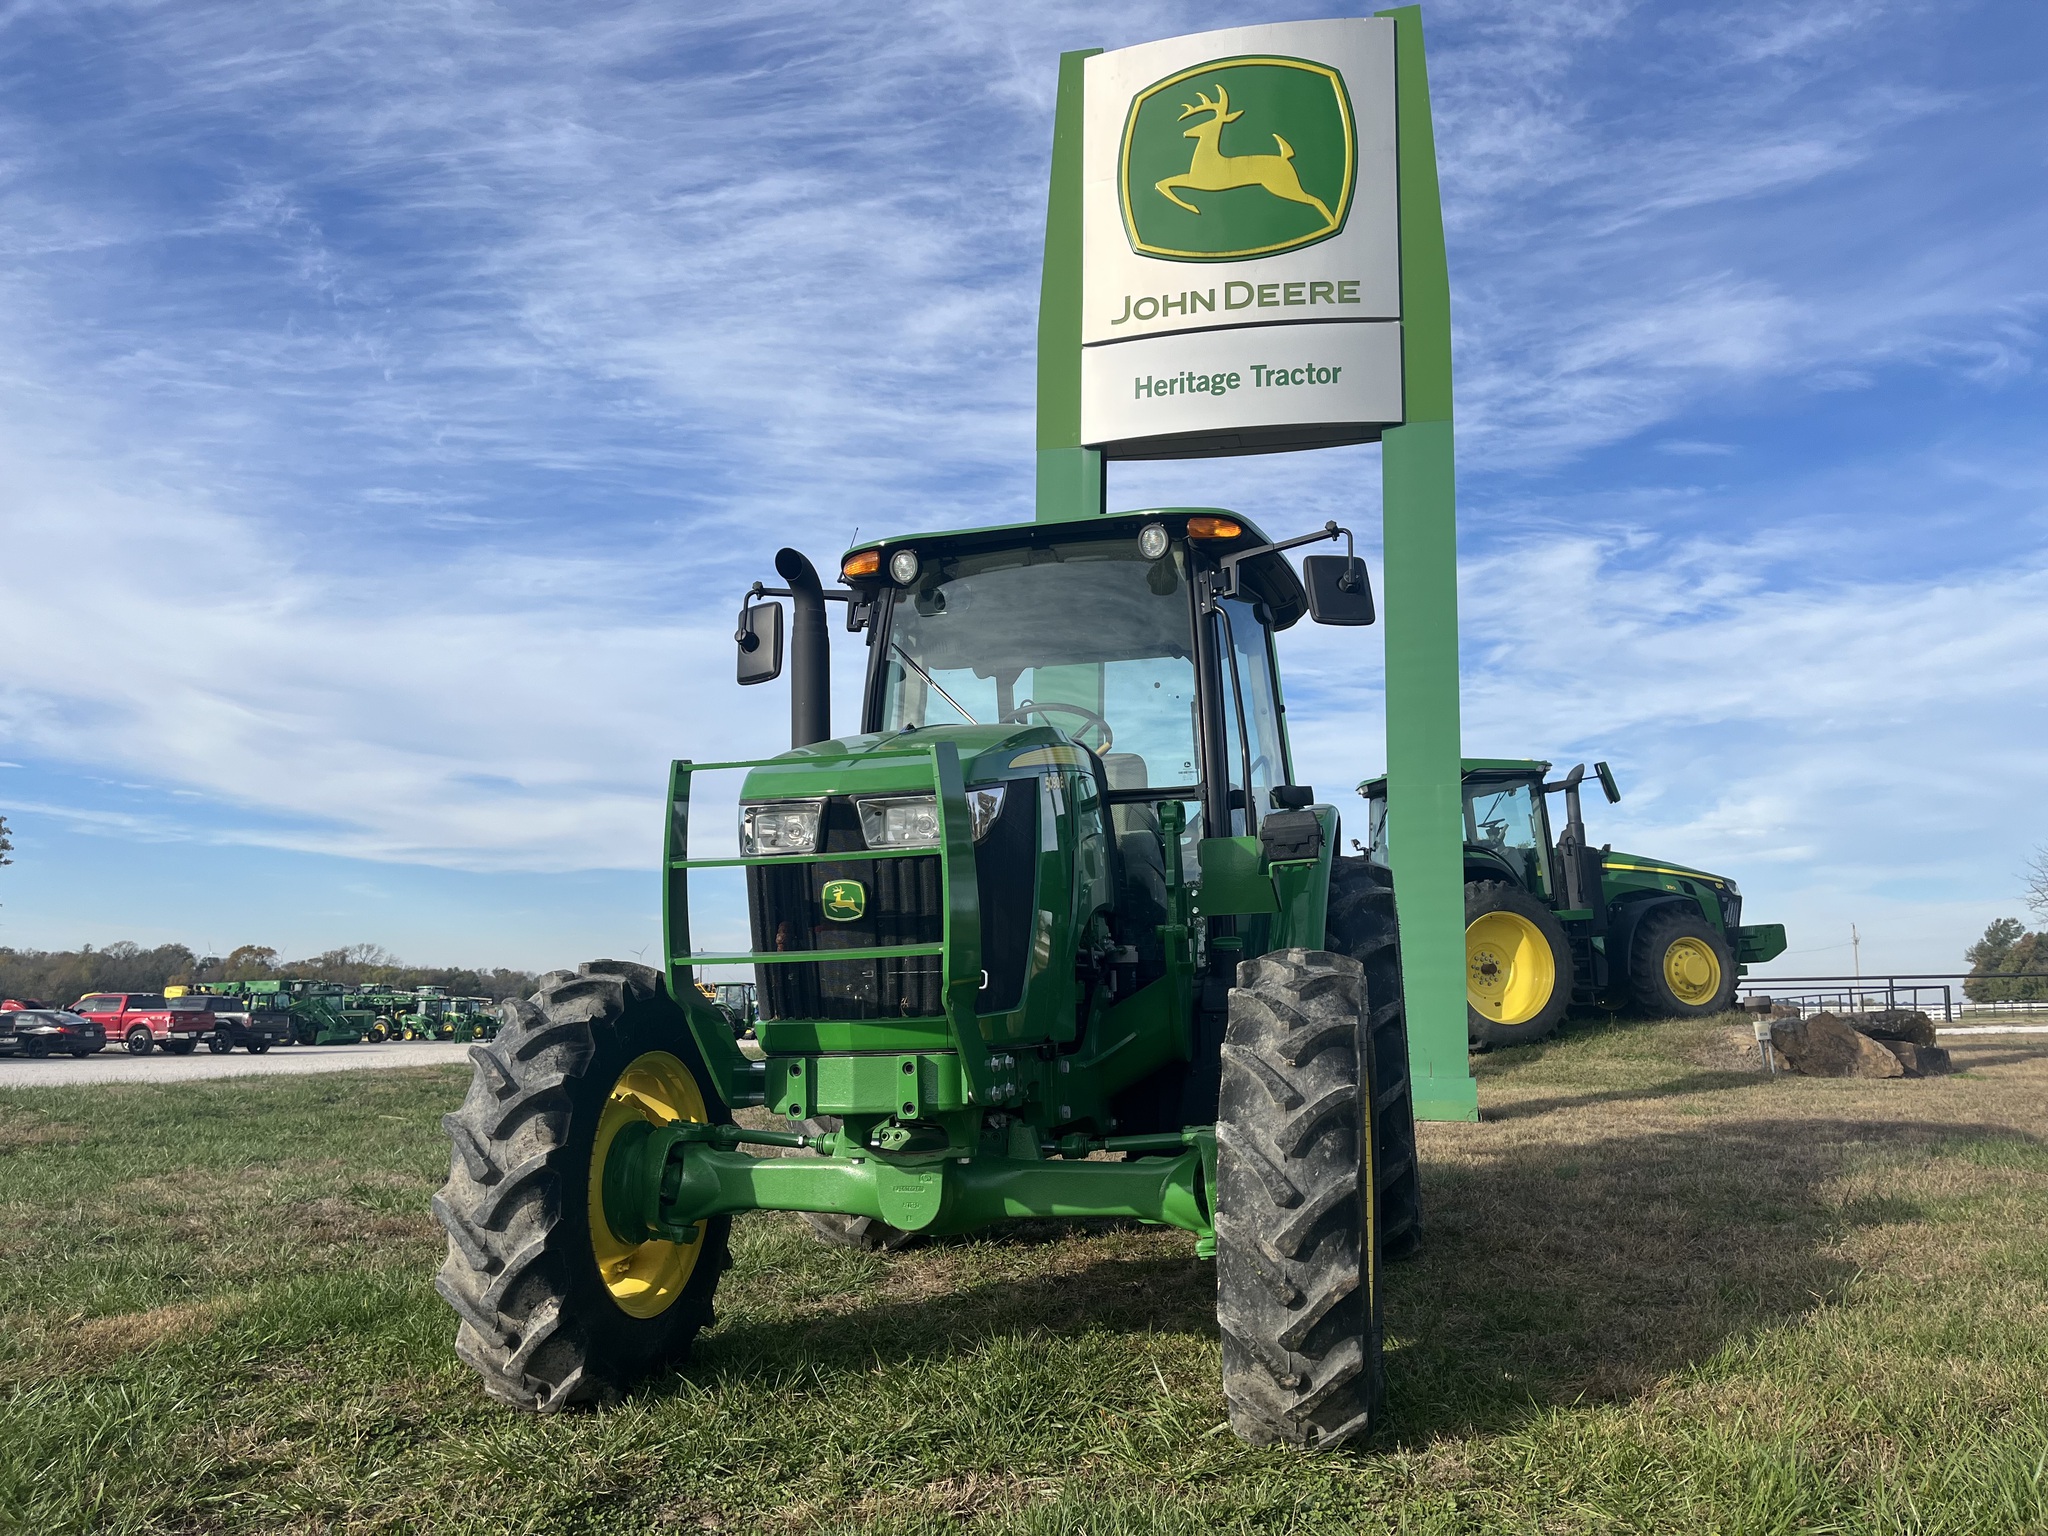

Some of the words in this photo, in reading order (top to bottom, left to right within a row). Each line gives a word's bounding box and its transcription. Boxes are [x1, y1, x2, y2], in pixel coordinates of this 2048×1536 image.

[1111, 289, 1215, 325] JOHN
[1224, 280, 1360, 310] DEERE
[1134, 371, 1241, 400] Heritage
[1250, 363, 1342, 388] Tractor
